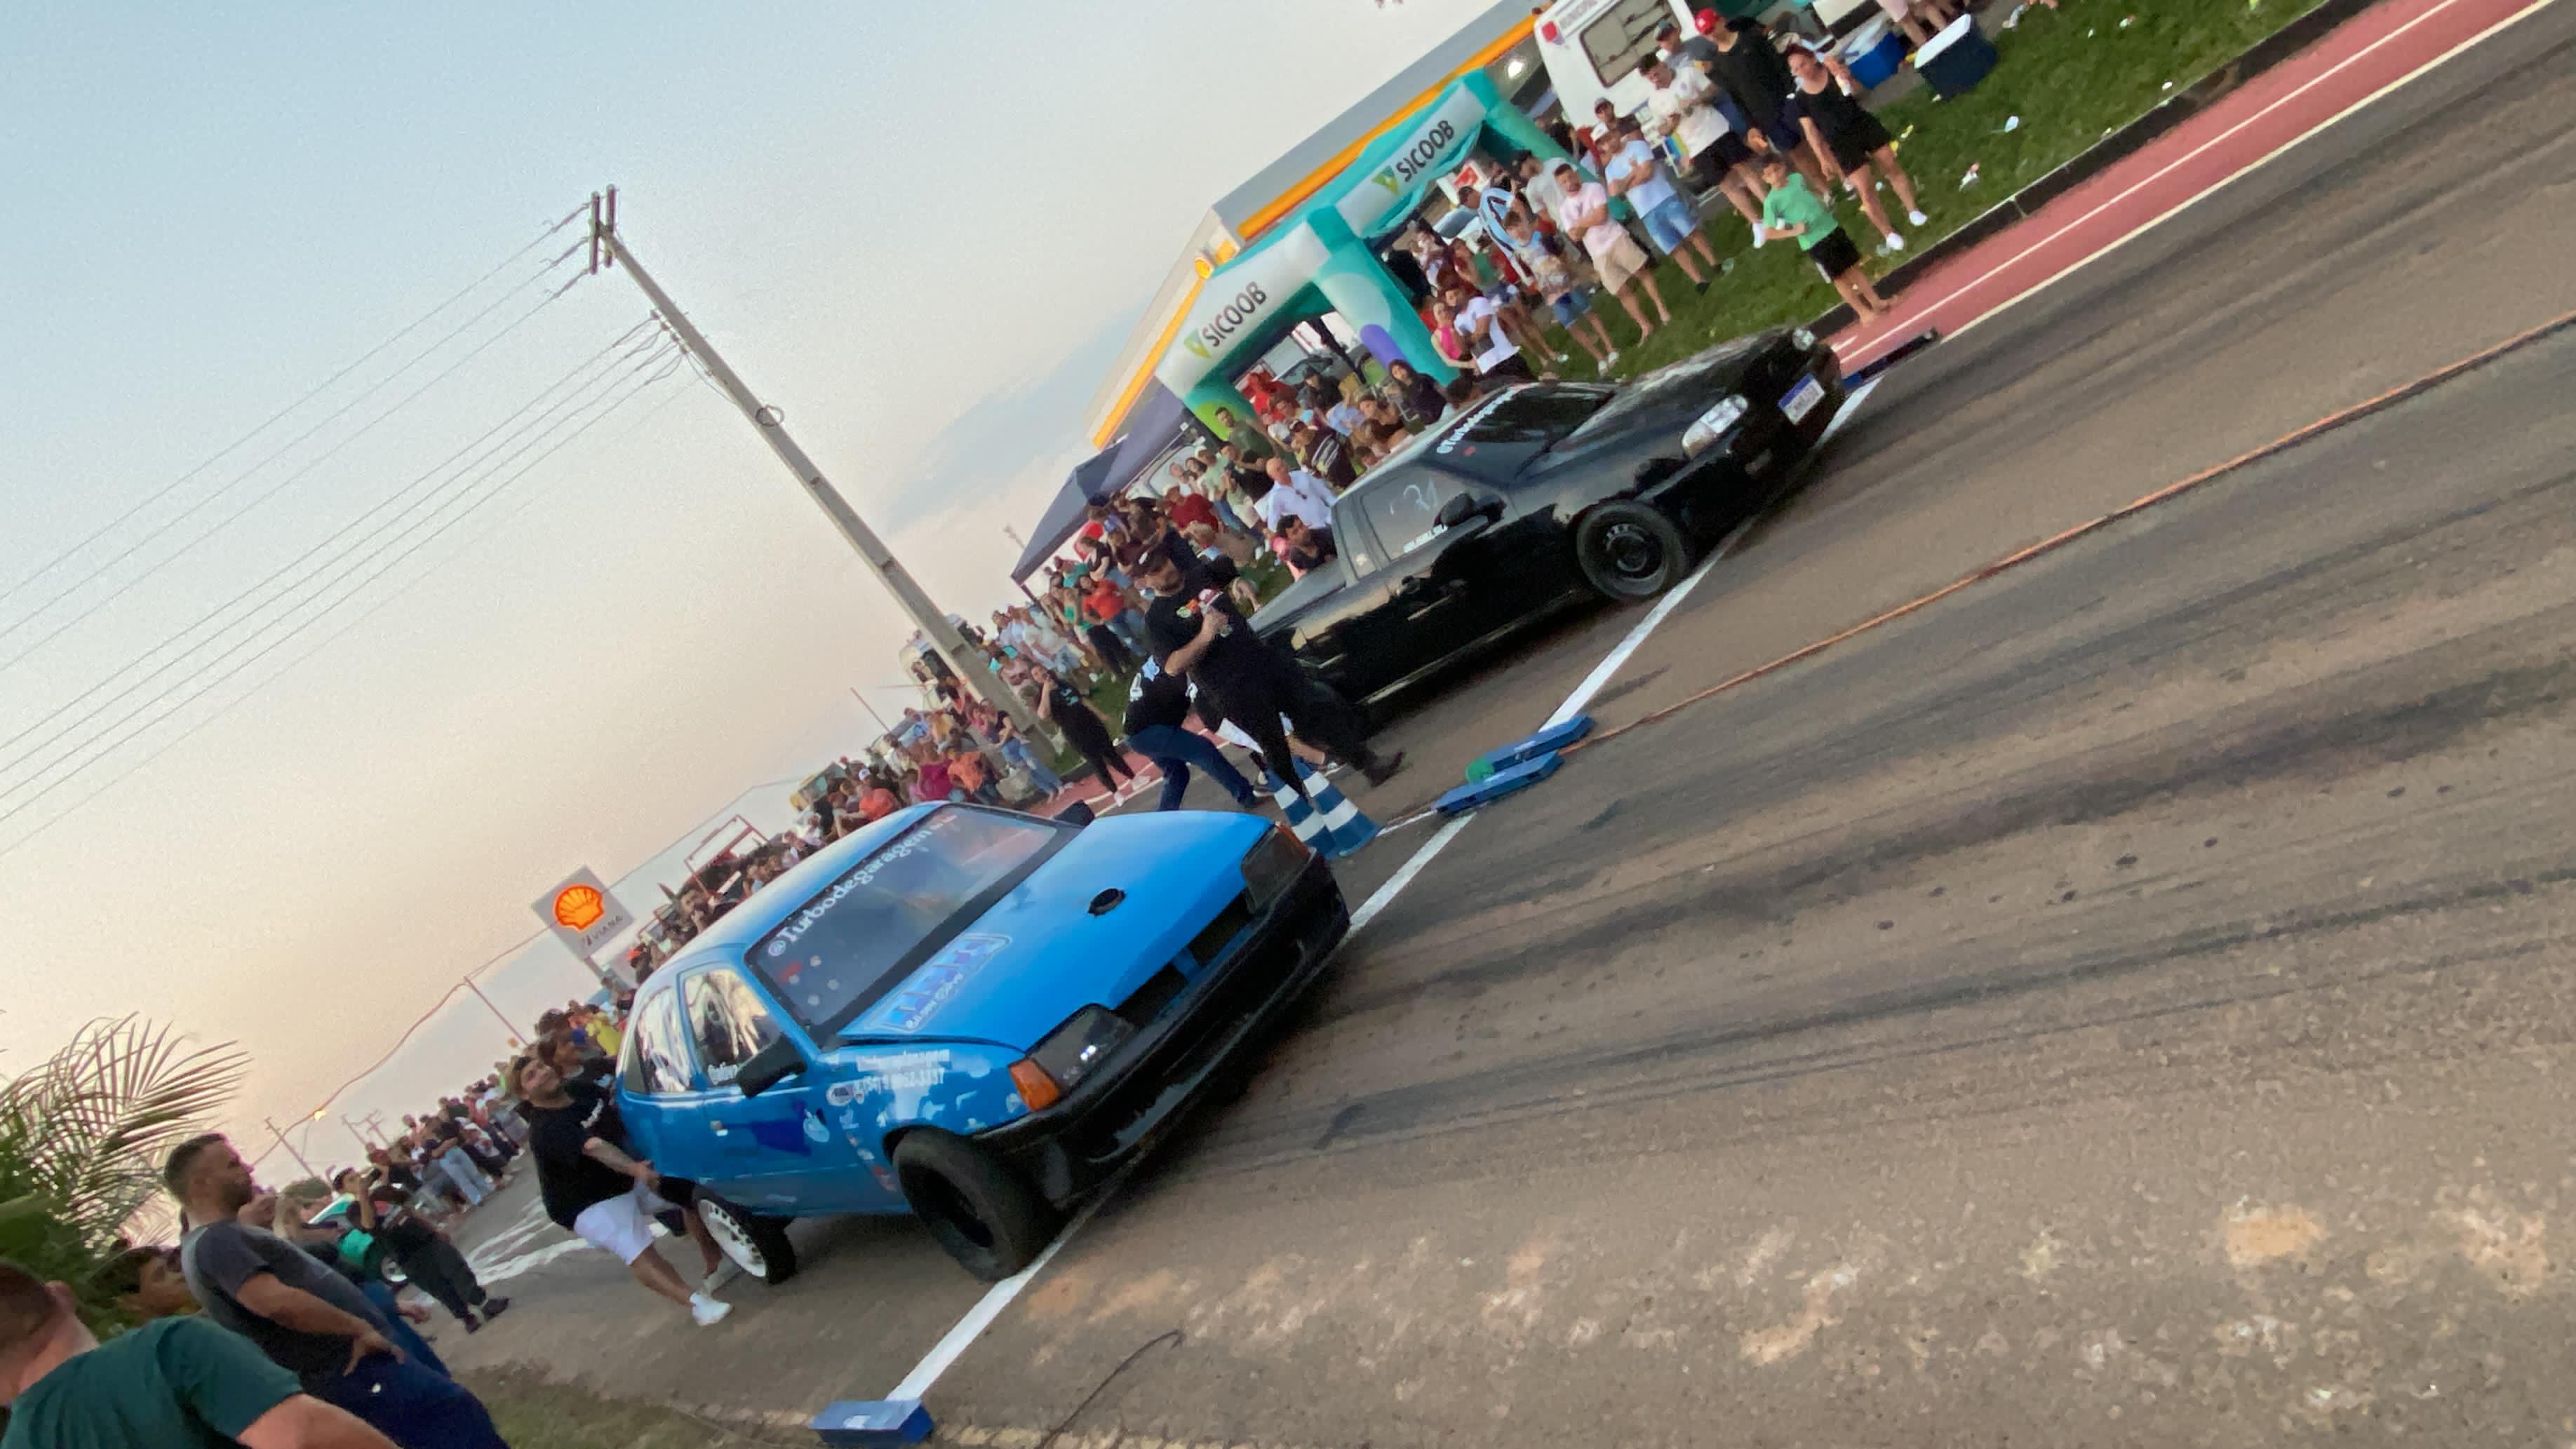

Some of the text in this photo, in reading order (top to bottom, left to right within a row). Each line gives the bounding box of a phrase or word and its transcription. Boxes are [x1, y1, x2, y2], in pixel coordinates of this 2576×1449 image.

[1396, 120, 1454, 182] SICOOB
[1202, 281, 1266, 347] SICOOB
[767, 828, 933, 957] @Turbodegaragem
